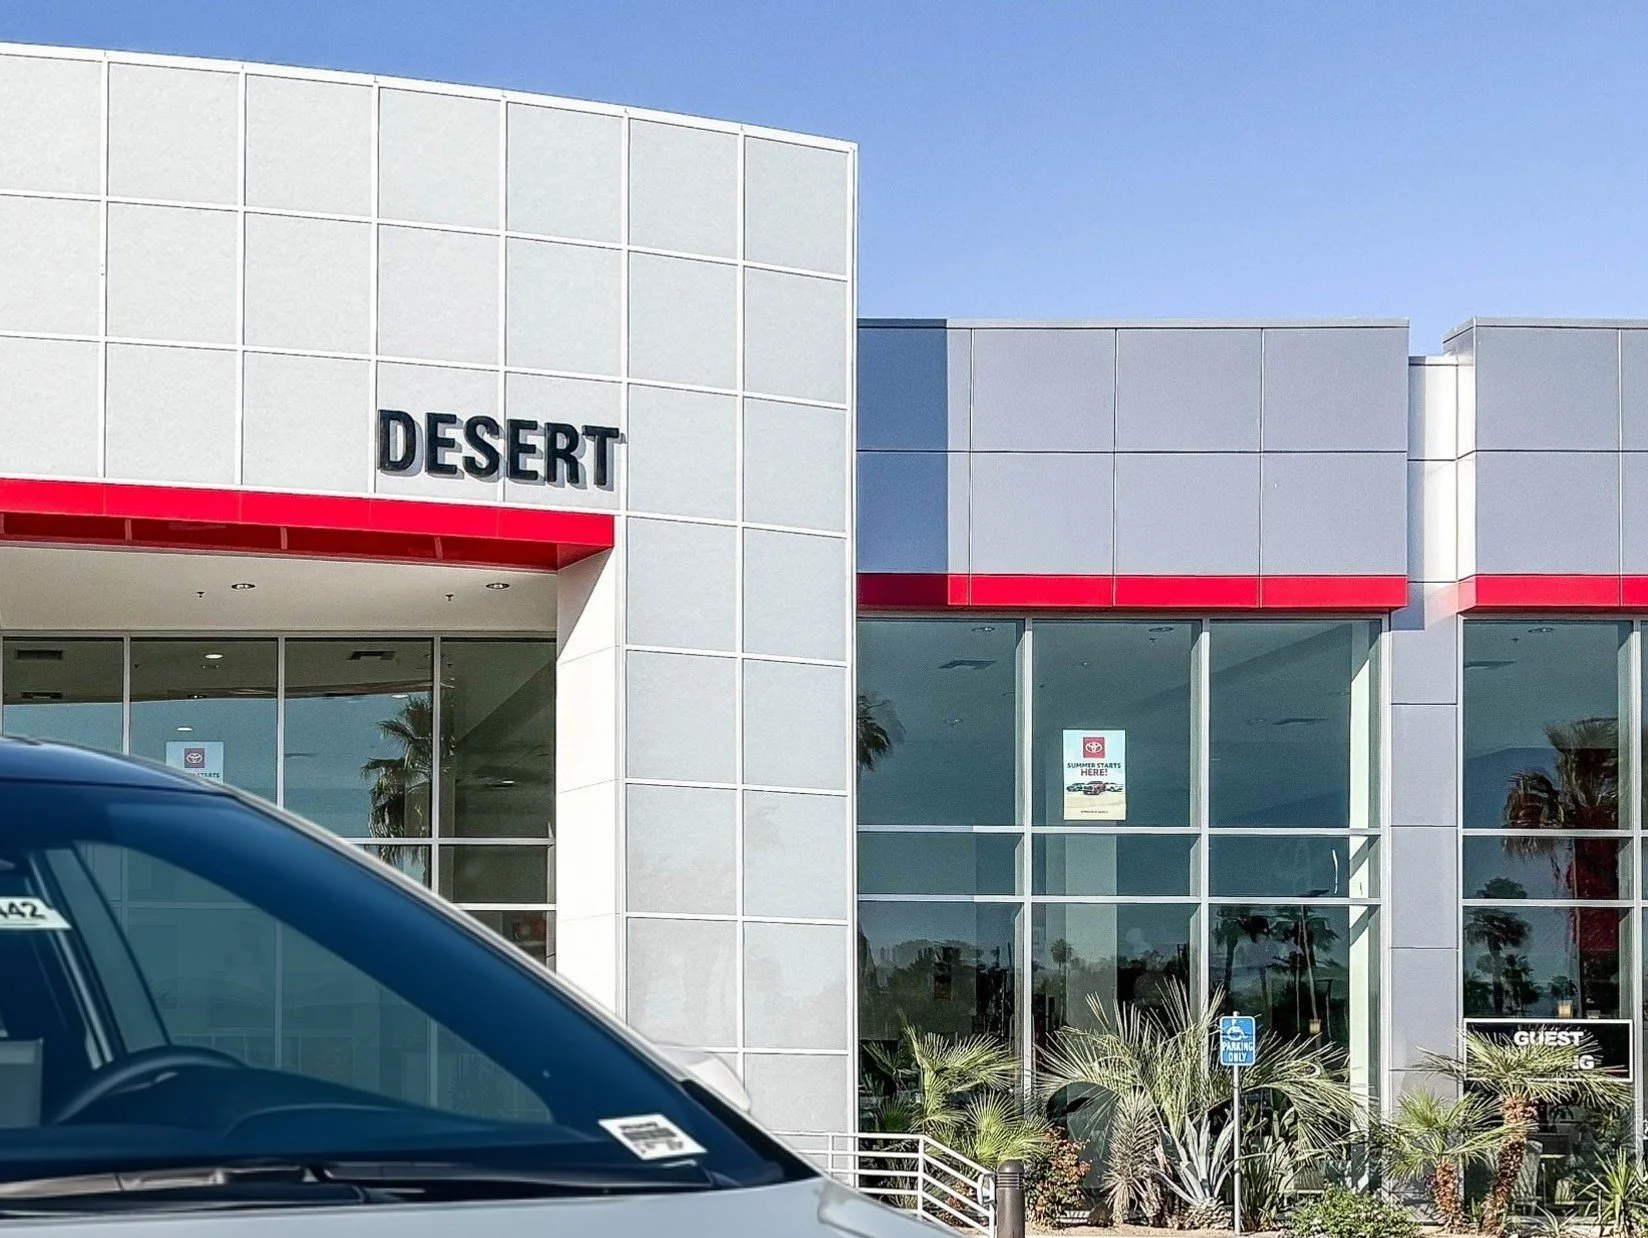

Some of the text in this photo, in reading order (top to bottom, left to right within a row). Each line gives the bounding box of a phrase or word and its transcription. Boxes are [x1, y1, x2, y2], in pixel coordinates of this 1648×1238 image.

[377, 409, 620, 488] DESERT
[1513, 1030, 1584, 1047] GUEST
[1222, 1041, 1253, 1052] PARKING
[1228, 1052, 1247, 1062] ONLY
